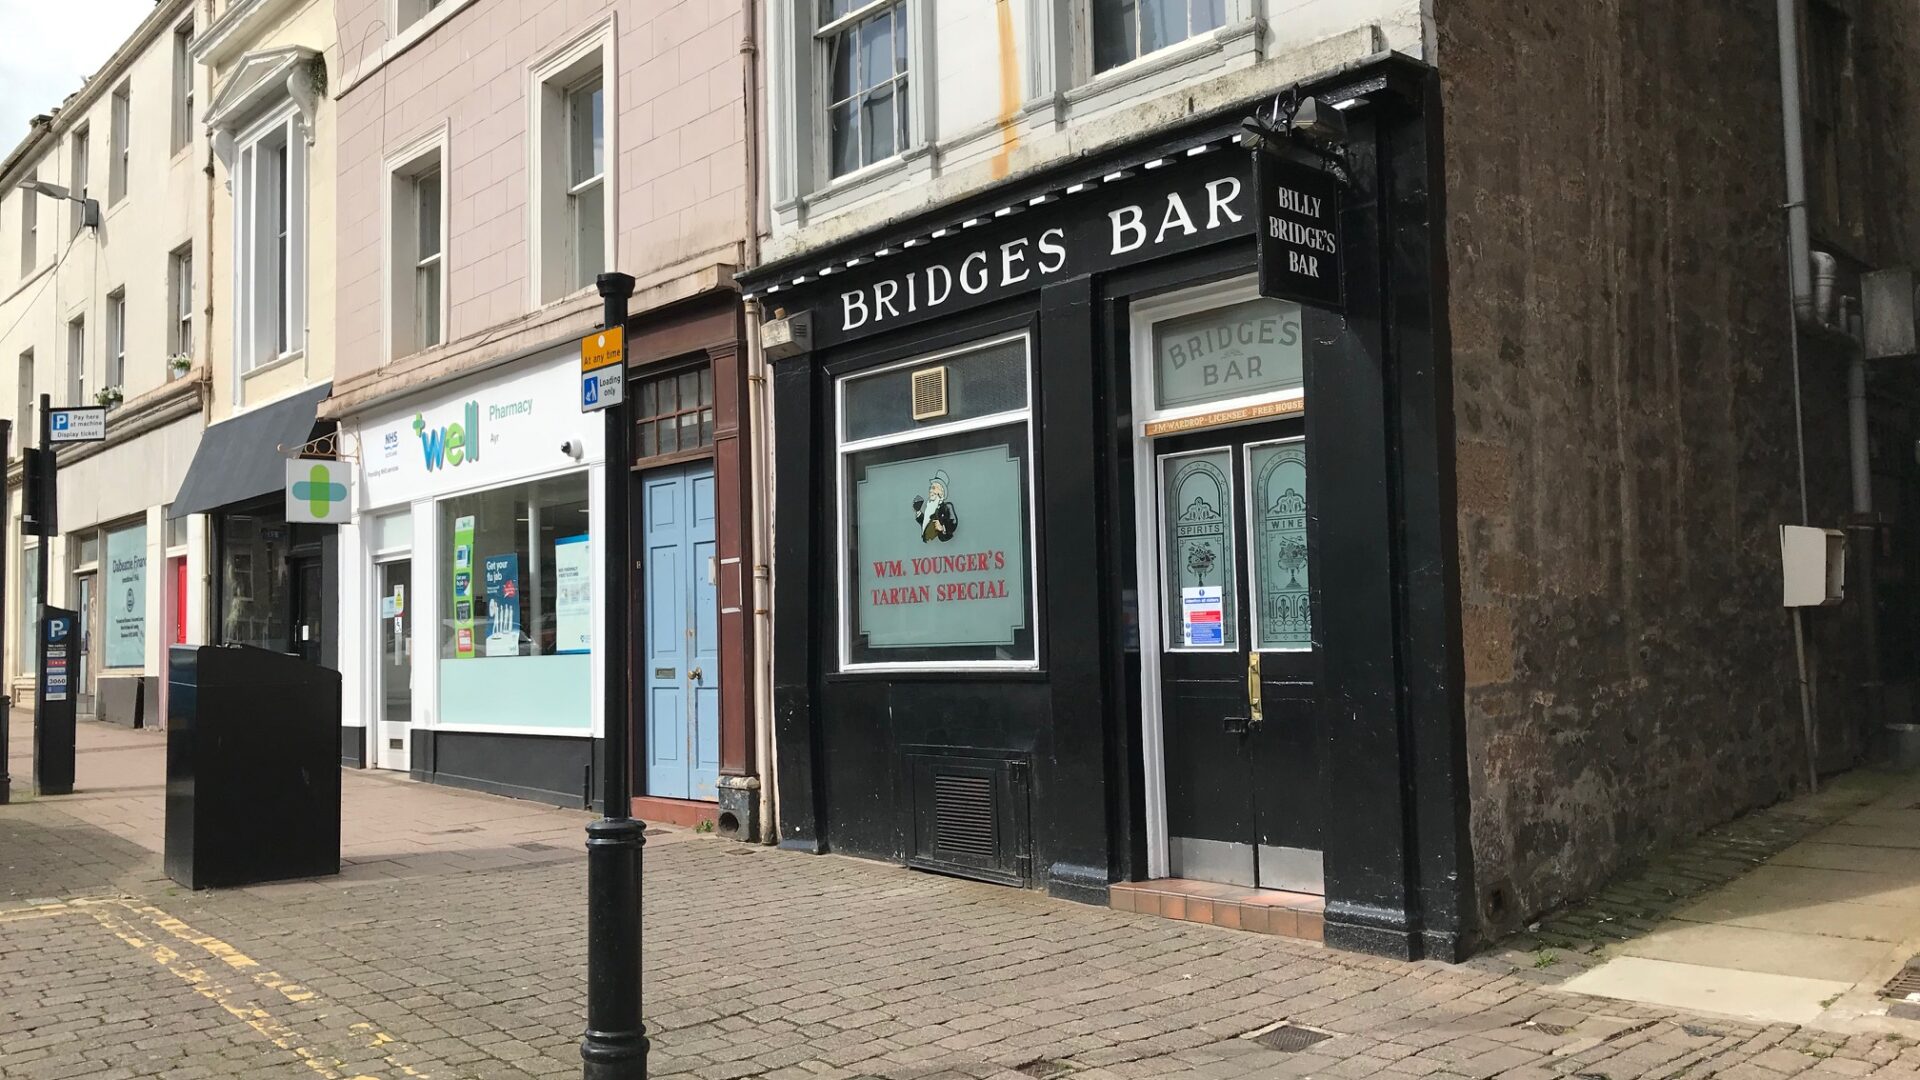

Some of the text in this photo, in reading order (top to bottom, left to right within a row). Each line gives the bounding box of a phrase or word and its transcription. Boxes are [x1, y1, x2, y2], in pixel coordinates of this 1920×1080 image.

[1279, 186, 1321, 218] BILLY
[1269, 216, 1335, 254] BRIDGE'S
[841, 176, 1243, 331] BRIDGES BAR
[1289, 250, 1319, 278] BAR
[1168, 315, 1300, 370] BRIDGE'S
[584, 349, 620, 366] At any time
[1203, 355, 1263, 386] BAR
[600, 376, 620, 388] Loading
[604, 387, 616, 397] only
[1253, 405, 1274, 416] FREE
[1275, 400, 1304, 412] HOUSE
[56, 415, 67, 430] P
[385, 431, 398, 445] NHS
[422, 398, 533, 472] well Pharmacy
[490, 433, 500, 445] Ayr
[1180, 525, 1220, 536] SPIRITS
[487, 561, 508, 571] Get your
[873, 550, 1005, 578] WM. YOUNGER'S
[871, 580, 1009, 606] TARTAN SPECIAL
